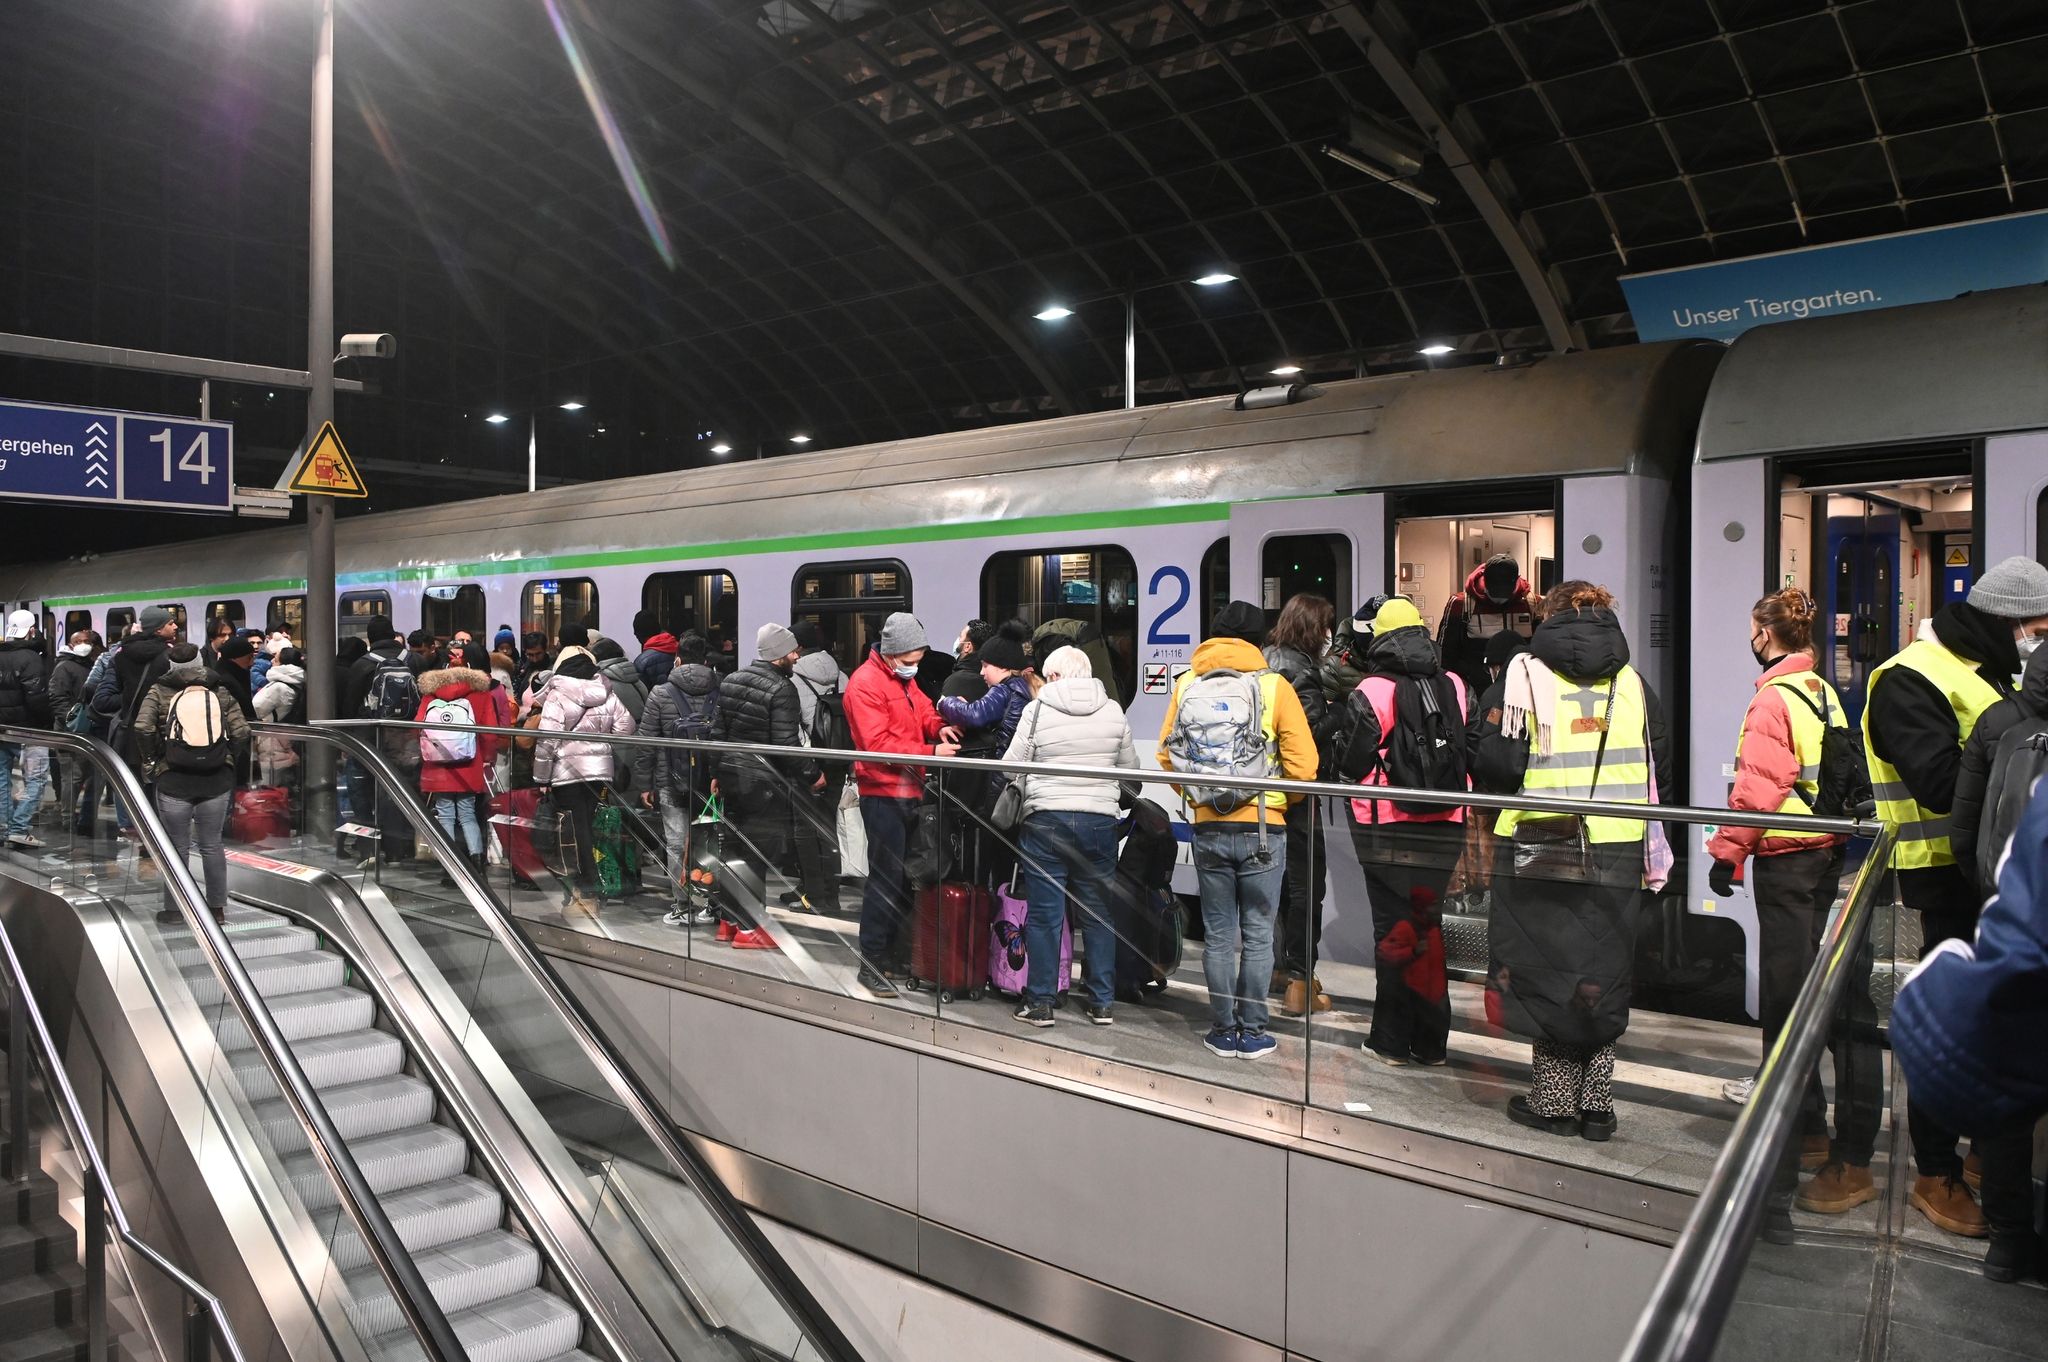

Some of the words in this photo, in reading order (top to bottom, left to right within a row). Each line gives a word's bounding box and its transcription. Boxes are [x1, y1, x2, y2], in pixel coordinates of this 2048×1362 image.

[1673, 307, 1740, 328] Unser
[1744, 289, 1882, 318] Tiergarten.
[0, 439, 74, 456] ergehen
[149, 428, 216, 485] 14
[1147, 565, 1191, 645] 2
[1160, 649, 1183, 658] 11-116
